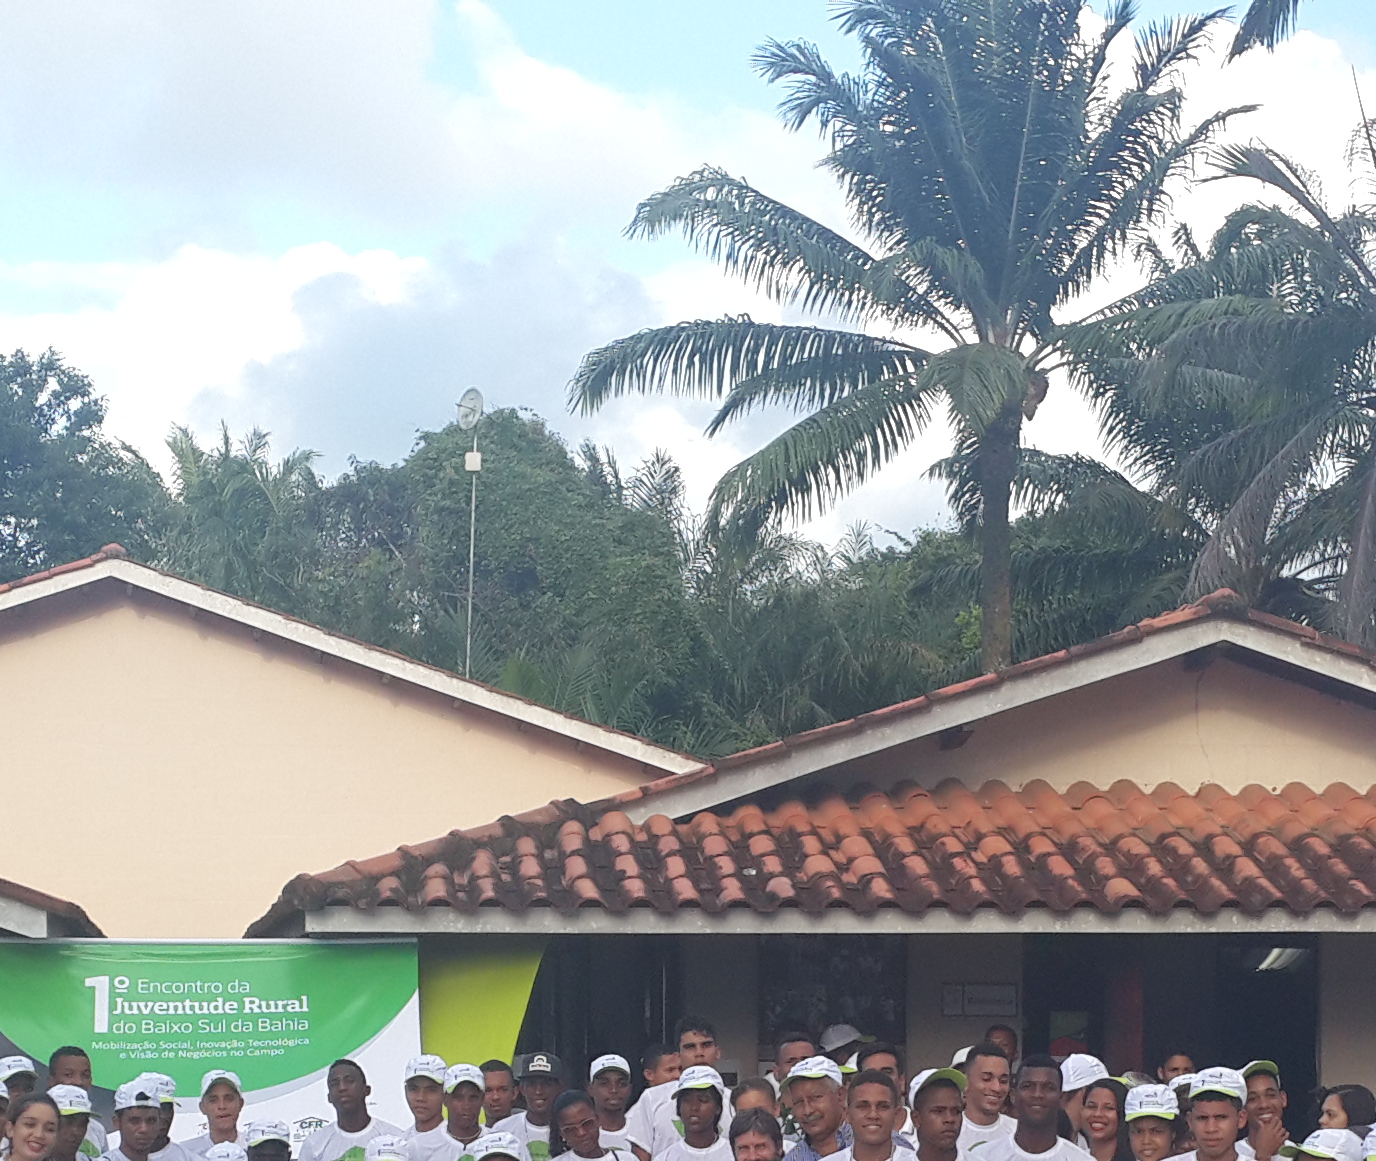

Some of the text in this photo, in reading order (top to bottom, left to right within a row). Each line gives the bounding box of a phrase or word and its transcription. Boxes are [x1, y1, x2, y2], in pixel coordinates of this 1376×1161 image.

[84, 975, 250, 1034] 1º Encontro da
[112, 995, 309, 1015] Juventude Rural
[112, 1017, 309, 1035] do Baixo Sul da Bahia
[91, 1036, 310, 1051] Mobilização Social, Inovação Tecnológica
[129, 1049, 159, 1059] Visão
[161, 1050, 176, 1059] de
[178, 1048, 227, 1060] Negócios
[246, 1047, 285, 1059] Campo
